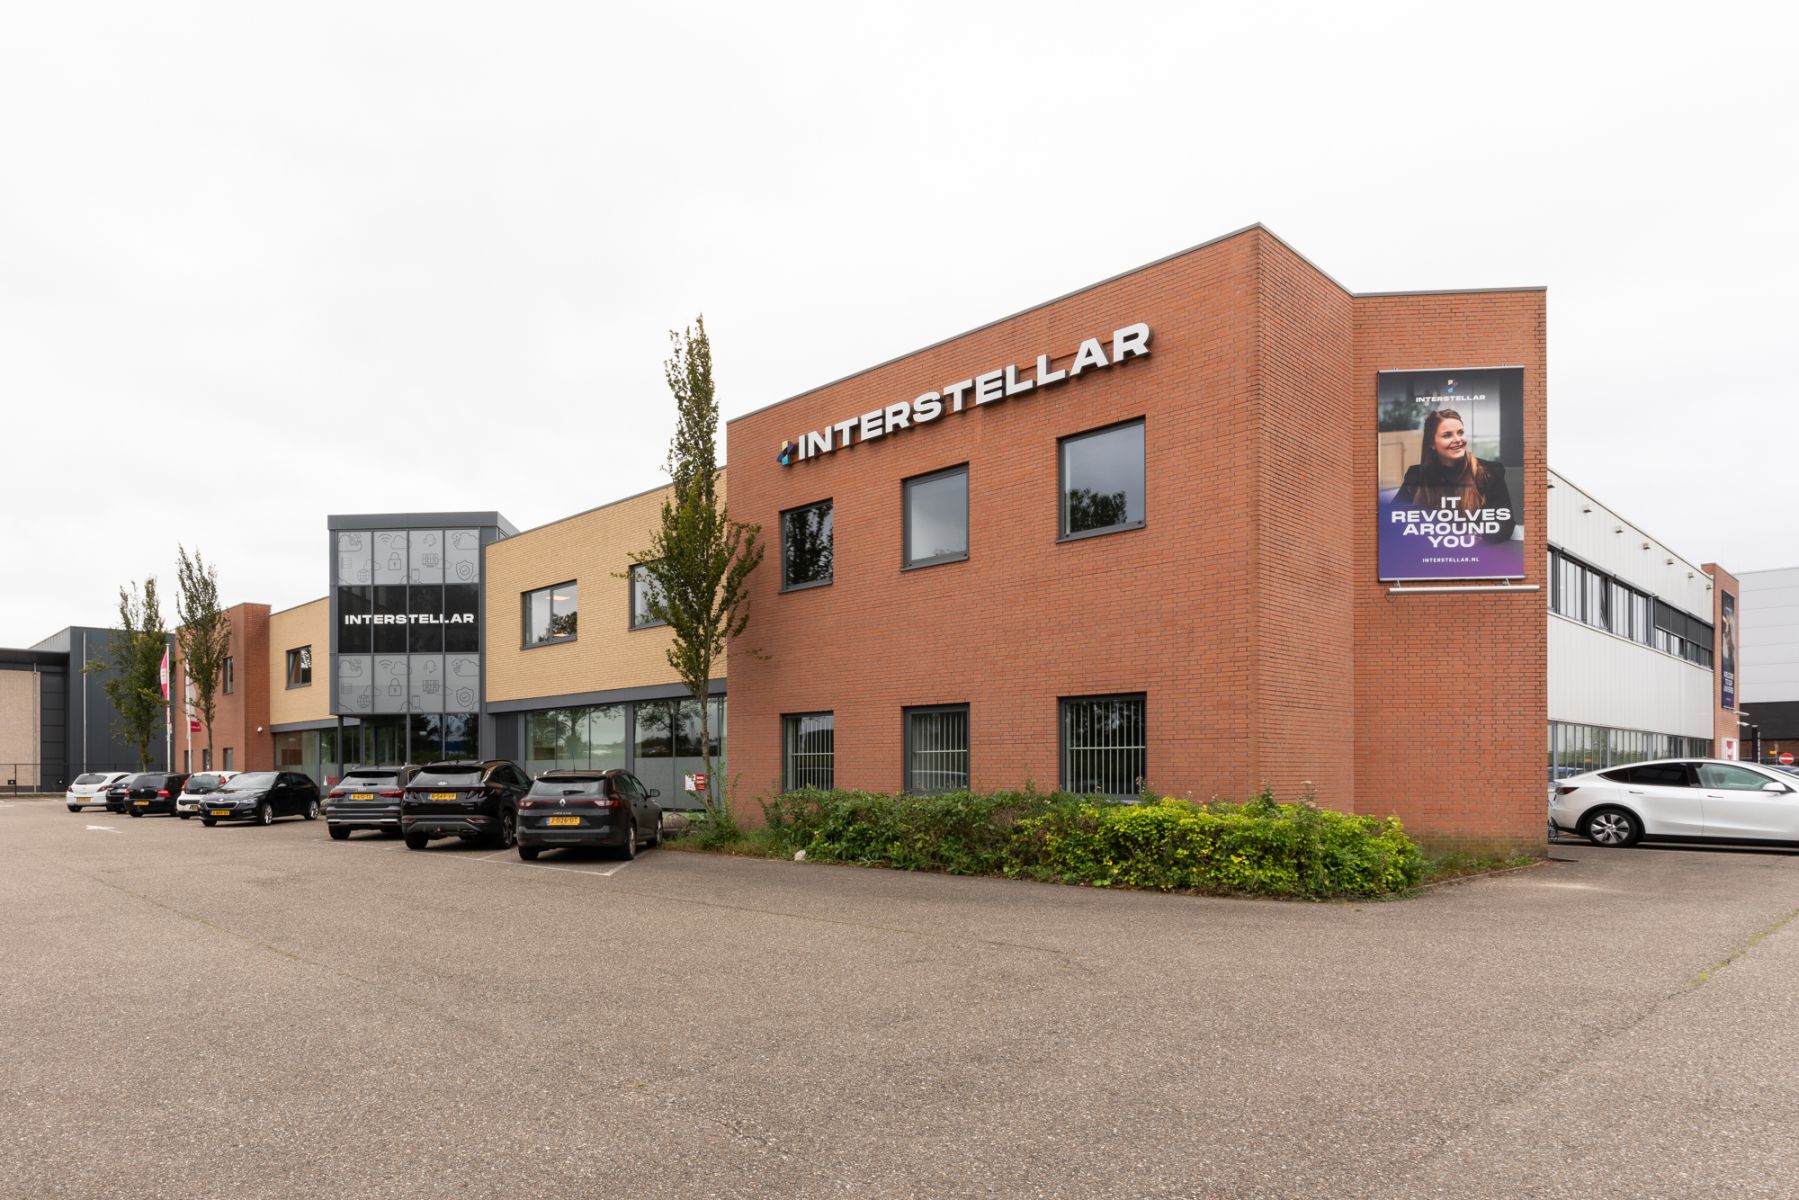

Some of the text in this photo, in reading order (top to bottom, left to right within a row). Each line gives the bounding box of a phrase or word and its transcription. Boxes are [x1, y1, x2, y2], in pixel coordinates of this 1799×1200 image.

[798, 322, 1152, 460] INTERSTELLAR
[1416, 394, 1486, 402] INTERSTELLAR
[1441, 496, 1461, 509] IT
[1391, 508, 1511, 523] REVOLVES
[1403, 522, 1500, 536] AROUND
[1427, 535, 1476, 548] YOU
[344, 614, 474, 624] INTERSTELLAR
